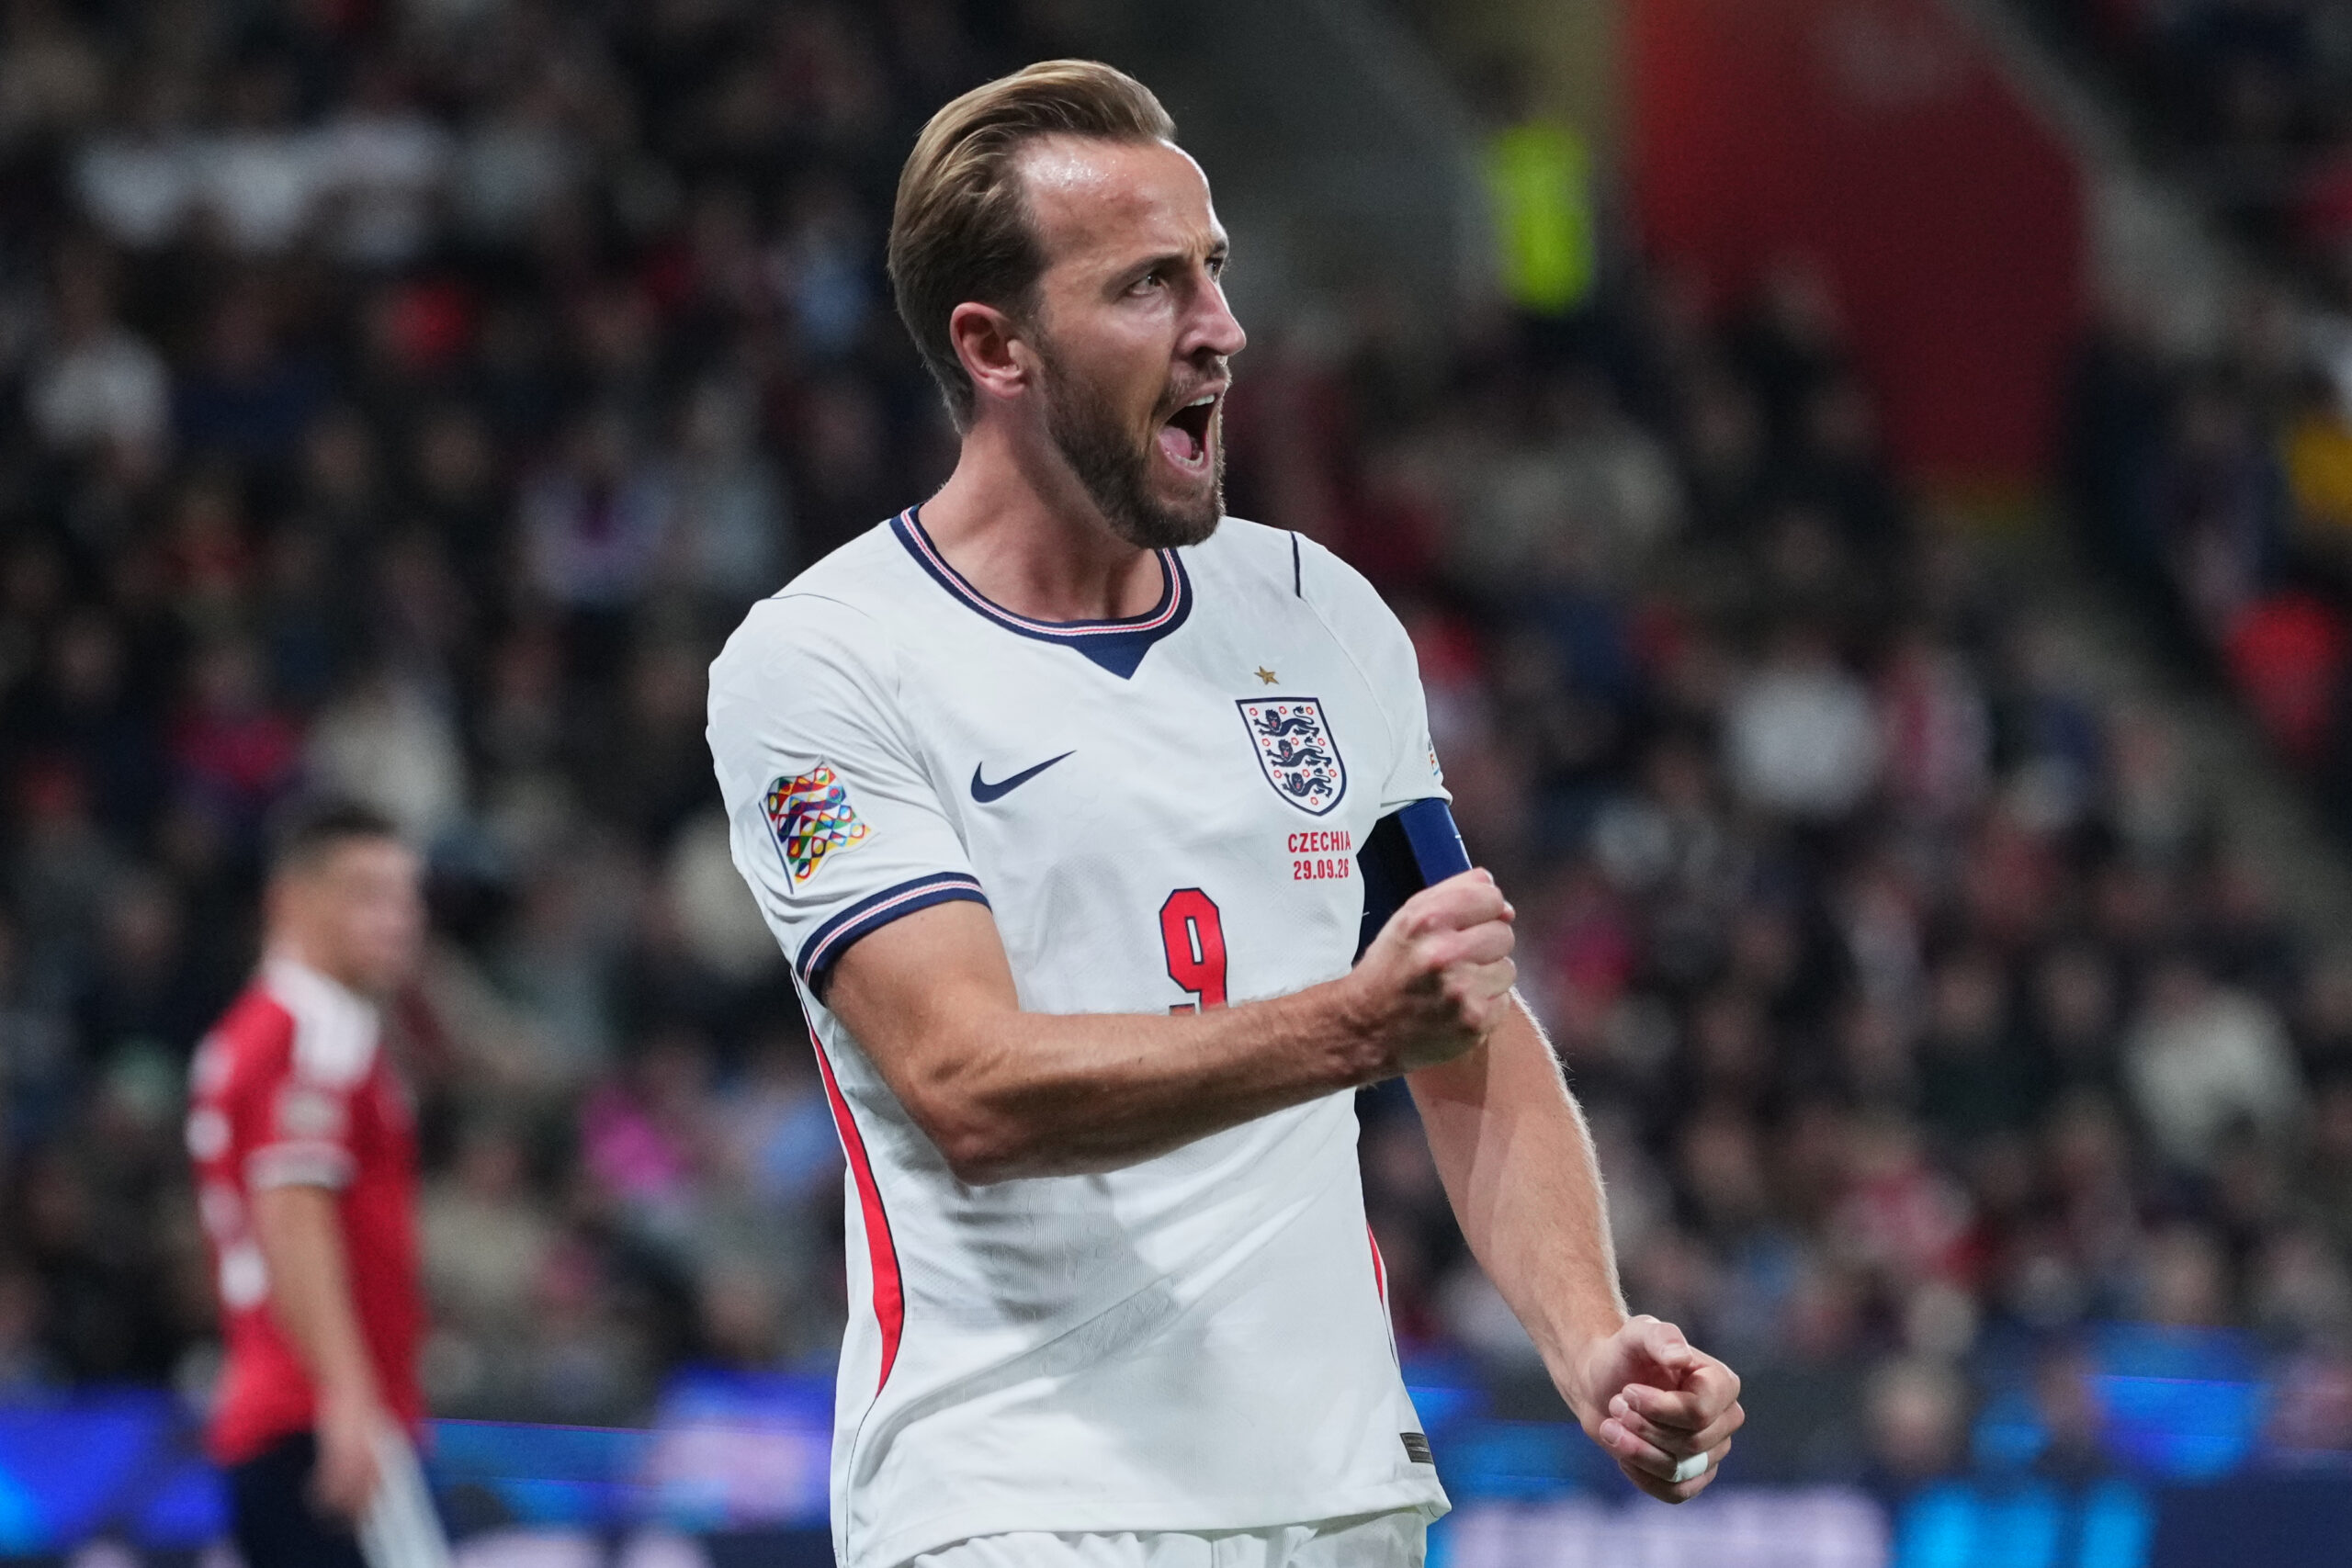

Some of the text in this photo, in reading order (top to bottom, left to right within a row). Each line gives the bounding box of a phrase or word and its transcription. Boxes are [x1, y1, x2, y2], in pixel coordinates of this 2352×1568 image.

[1288, 830, 1351, 853] CZECHIA
[1294, 858, 1349, 880] 29.09.26
[1159, 887, 1228, 1016] 9
